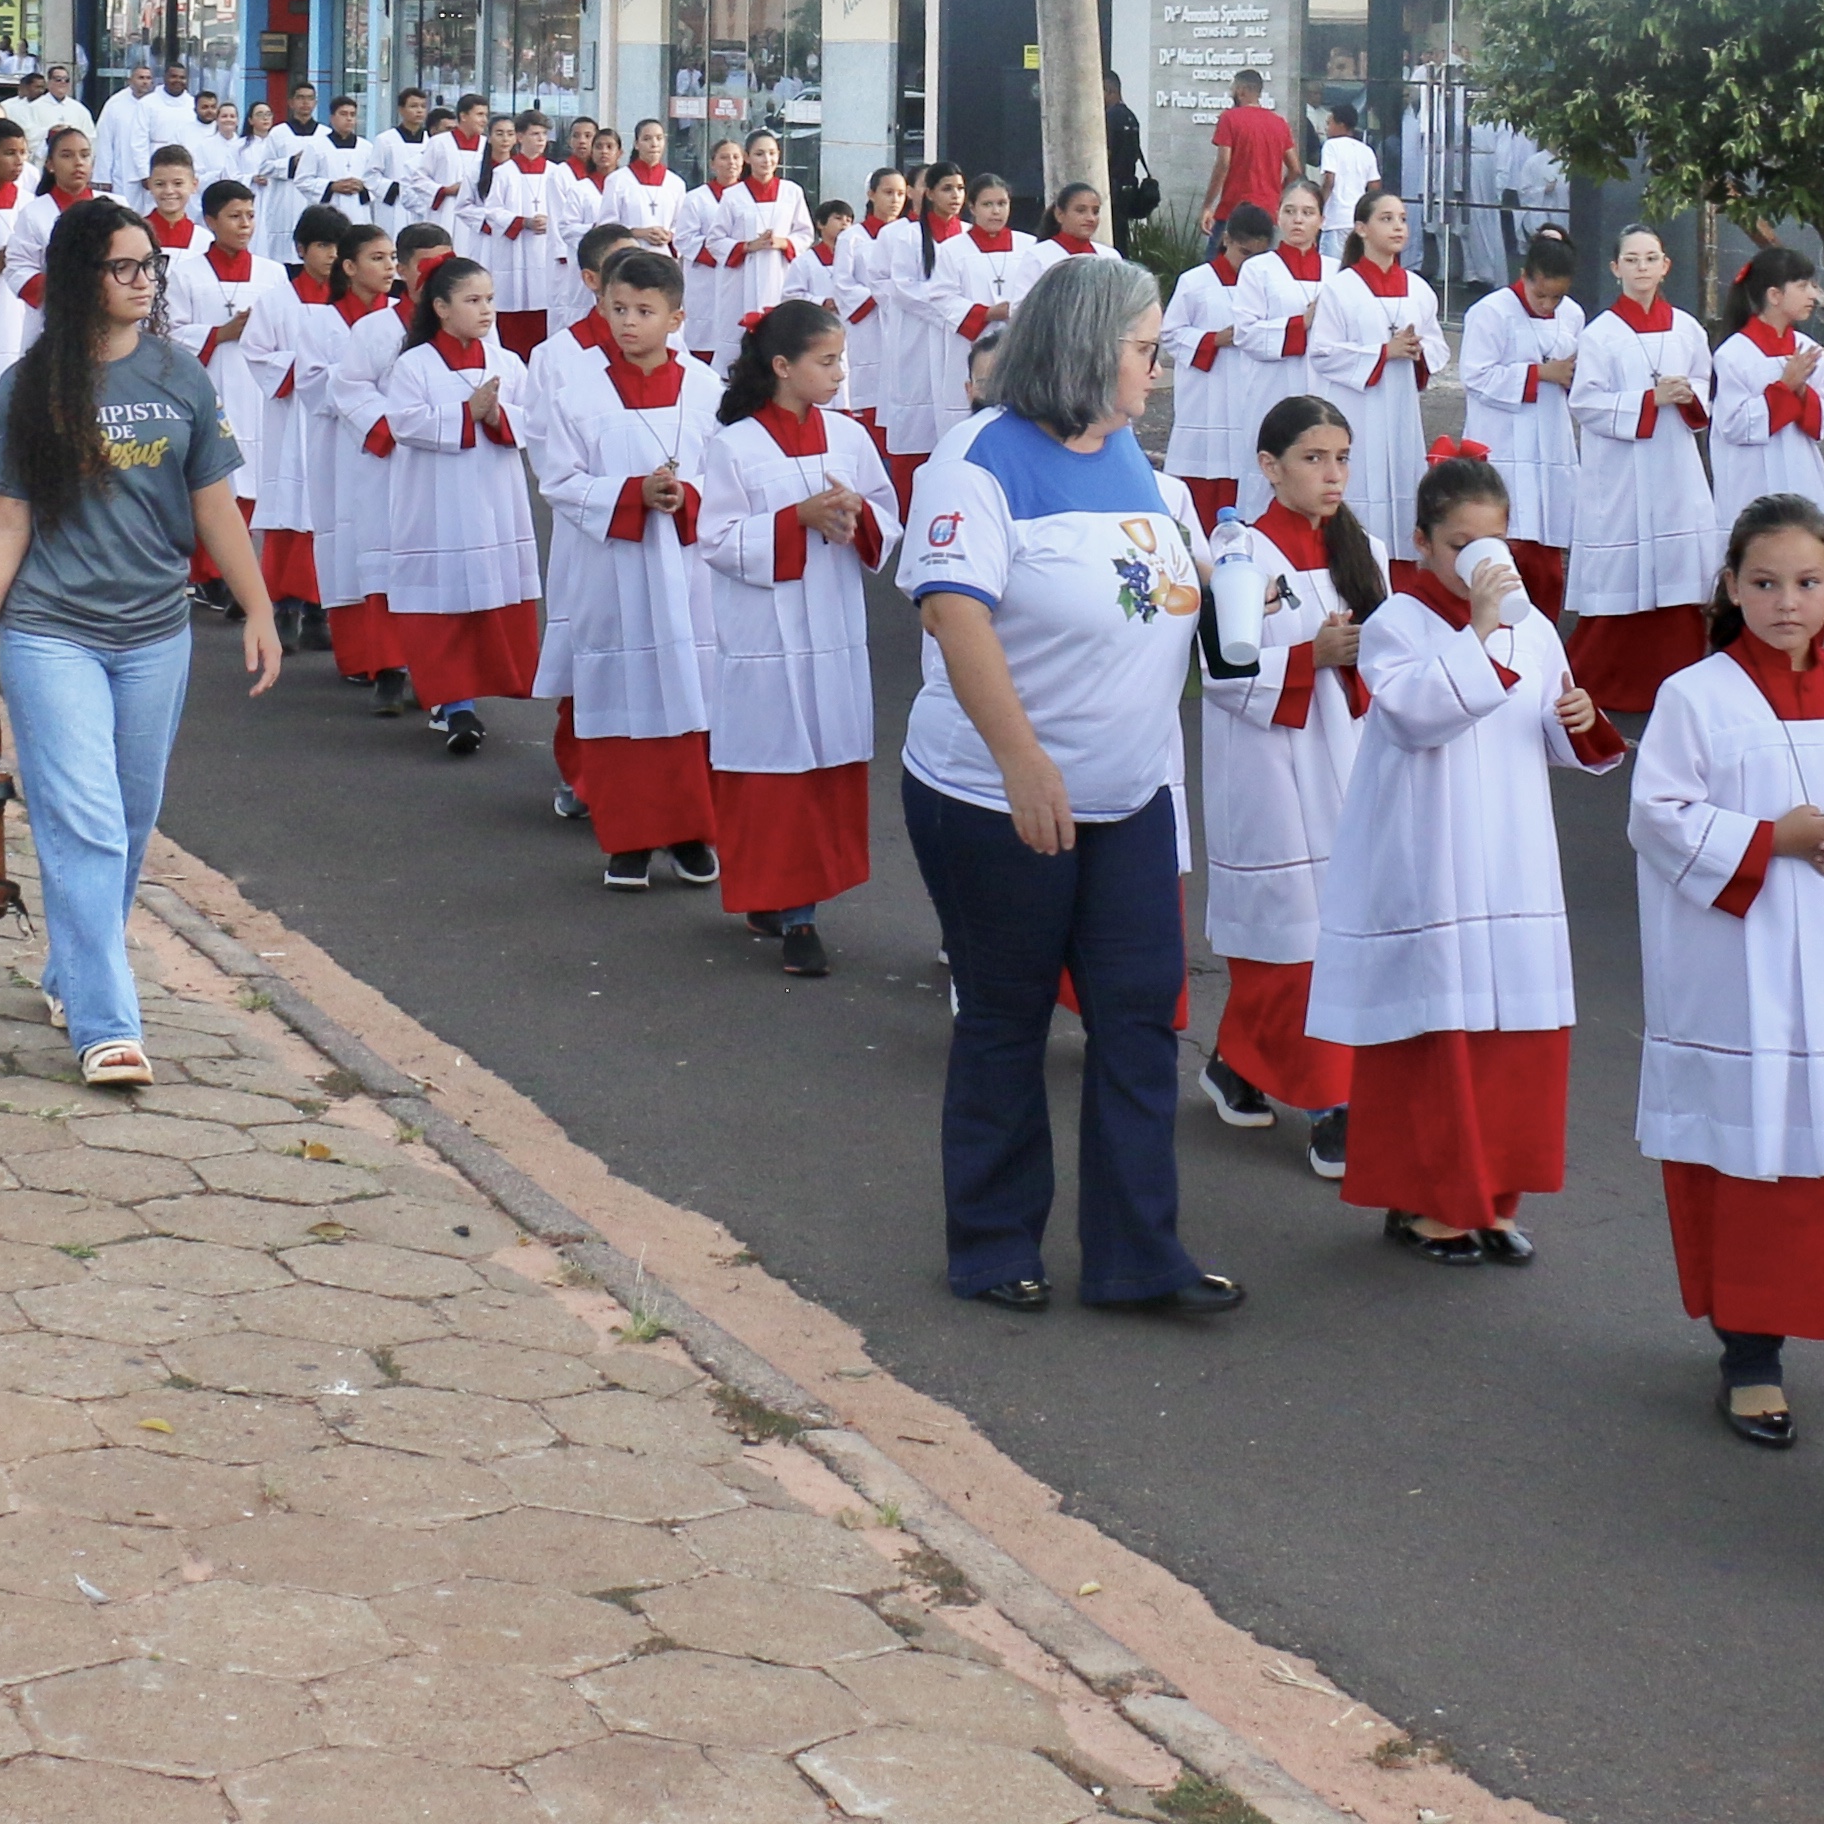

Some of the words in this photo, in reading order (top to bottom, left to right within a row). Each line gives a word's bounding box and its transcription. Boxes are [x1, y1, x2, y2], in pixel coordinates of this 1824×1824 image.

[1176, 47, 1205, 66] Maria
[1171, 90, 1197, 109] Paulo
[96, 402, 181, 424] PISTA
[107, 424, 136, 441] DE
